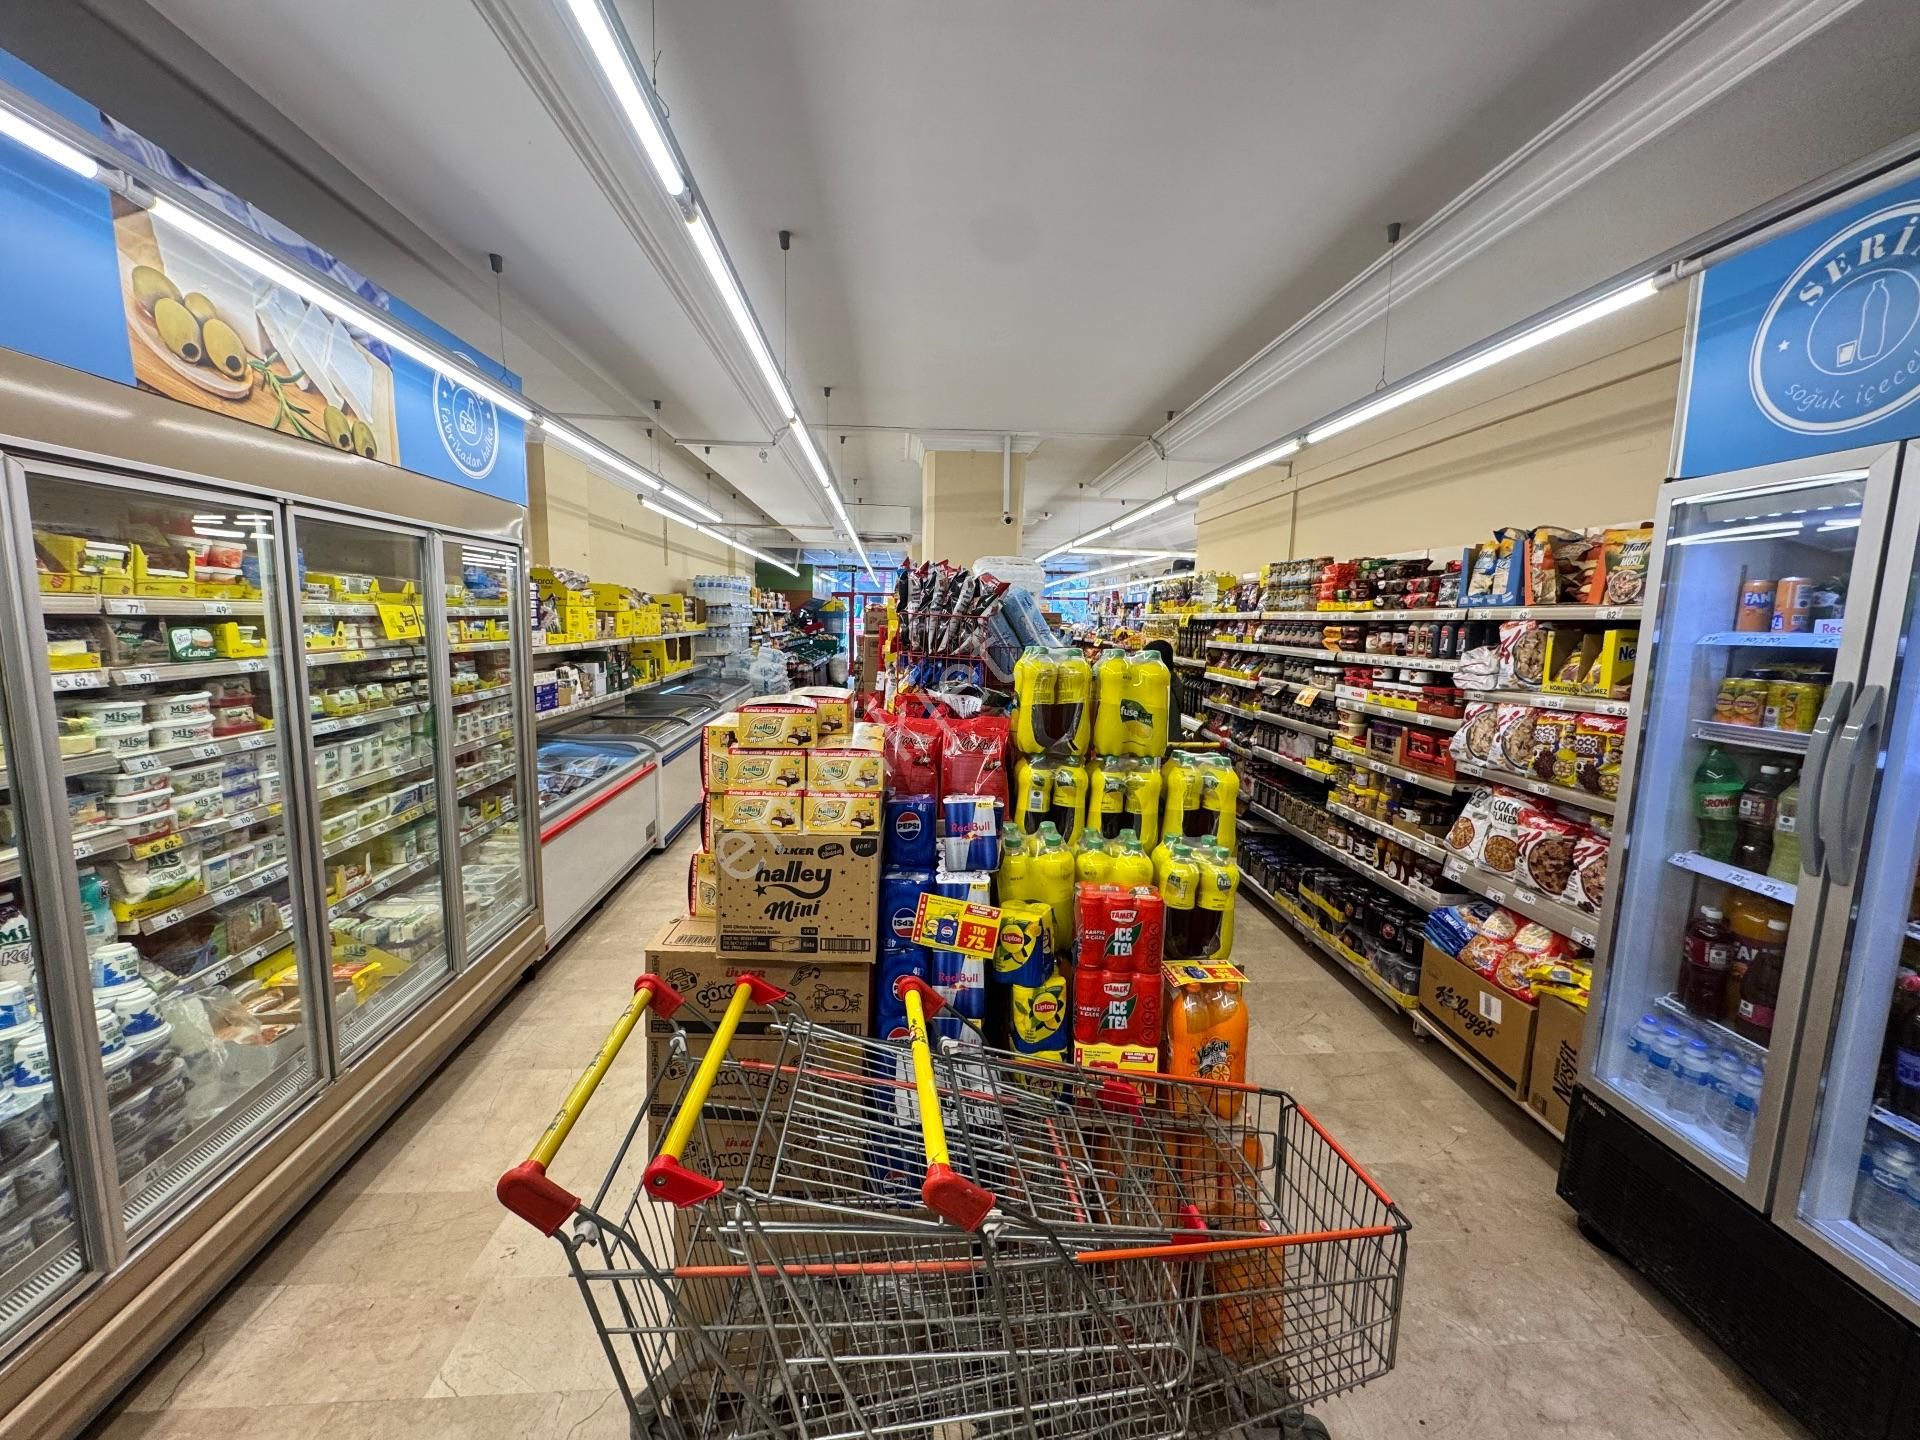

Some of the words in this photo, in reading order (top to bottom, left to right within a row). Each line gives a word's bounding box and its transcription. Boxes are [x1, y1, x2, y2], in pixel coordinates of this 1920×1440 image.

[1798, 216, 1920, 307] SERİ
[1785, 383, 1843, 412] soğuk
[1618, 646, 1637, 661] Ne
[74, 677, 88, 687] 62
[1120, 705, 1139, 718] fuse
[1616, 707, 1628, 715] 52
[1493, 799, 1521, 814] CORN
[897, 822, 920, 830] PEPSI
[972, 821, 990, 831] Bull
[774, 844, 815, 856] ÜLKER
[754, 860, 833, 900] halley
[1217, 877, 1231, 888] fus
[764, 900, 821, 922] Mini
[1111, 911, 1135, 919] TAMEK
[165, 913, 179, 924] 43
[0, 924, 31, 943] Mi
[972, 925, 987, 936] 110
[1114, 927, 1133, 942] ICE
[966, 934, 986, 950] 75
[1002, 934, 1022, 943] Lipton
[1581, 935, 1591, 946] 25
[1113, 942, 1133, 956] TEA
[960, 973, 978, 983] Bull
[1104, 984, 1129, 993] TAMEK
[1108, 1001, 1128, 1015] ICE
[1435, 985, 1496, 1039] Kellogg's
[1107, 1015, 1128, 1030] TEA
